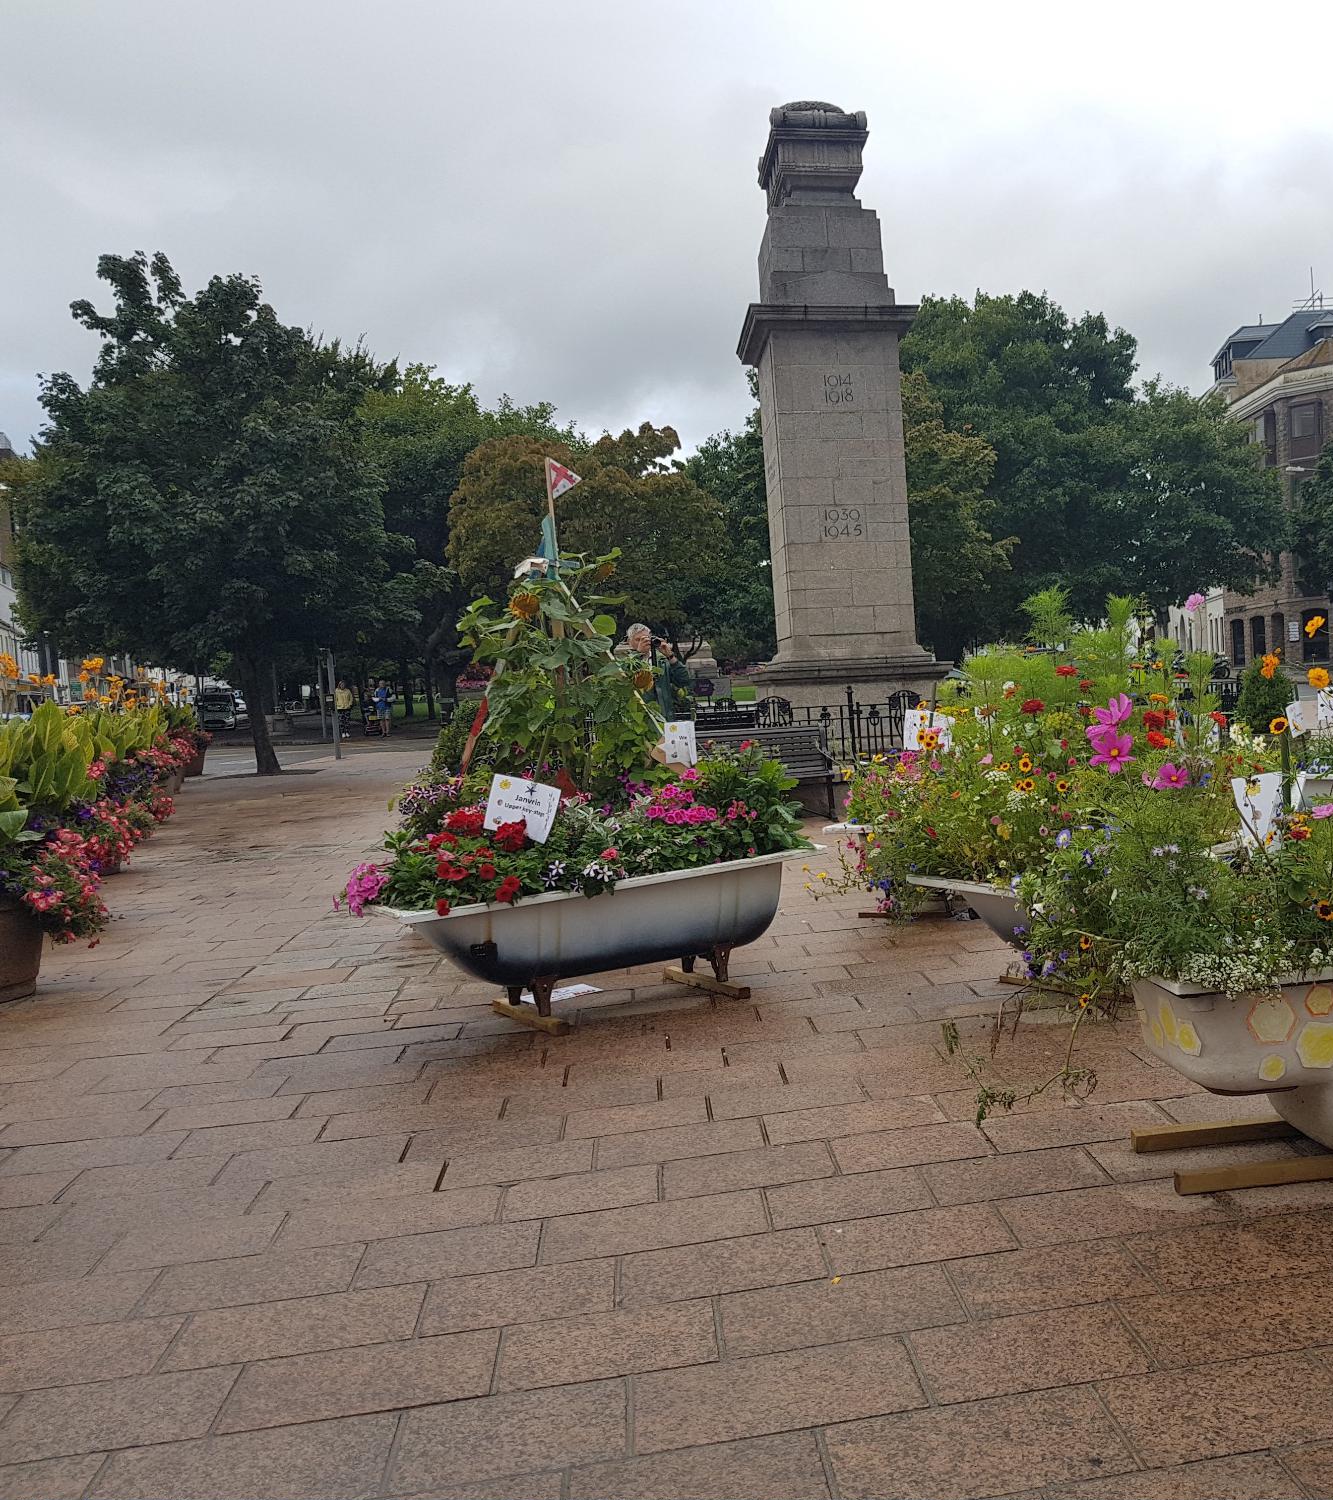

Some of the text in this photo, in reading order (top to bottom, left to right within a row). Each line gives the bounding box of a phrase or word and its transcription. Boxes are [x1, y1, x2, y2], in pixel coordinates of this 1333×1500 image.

[823, 373, 854, 387] 1914
[824, 388, 854, 405] 1918
[824, 508, 861, 524] 1939
[824, 524, 862, 540] 1945
